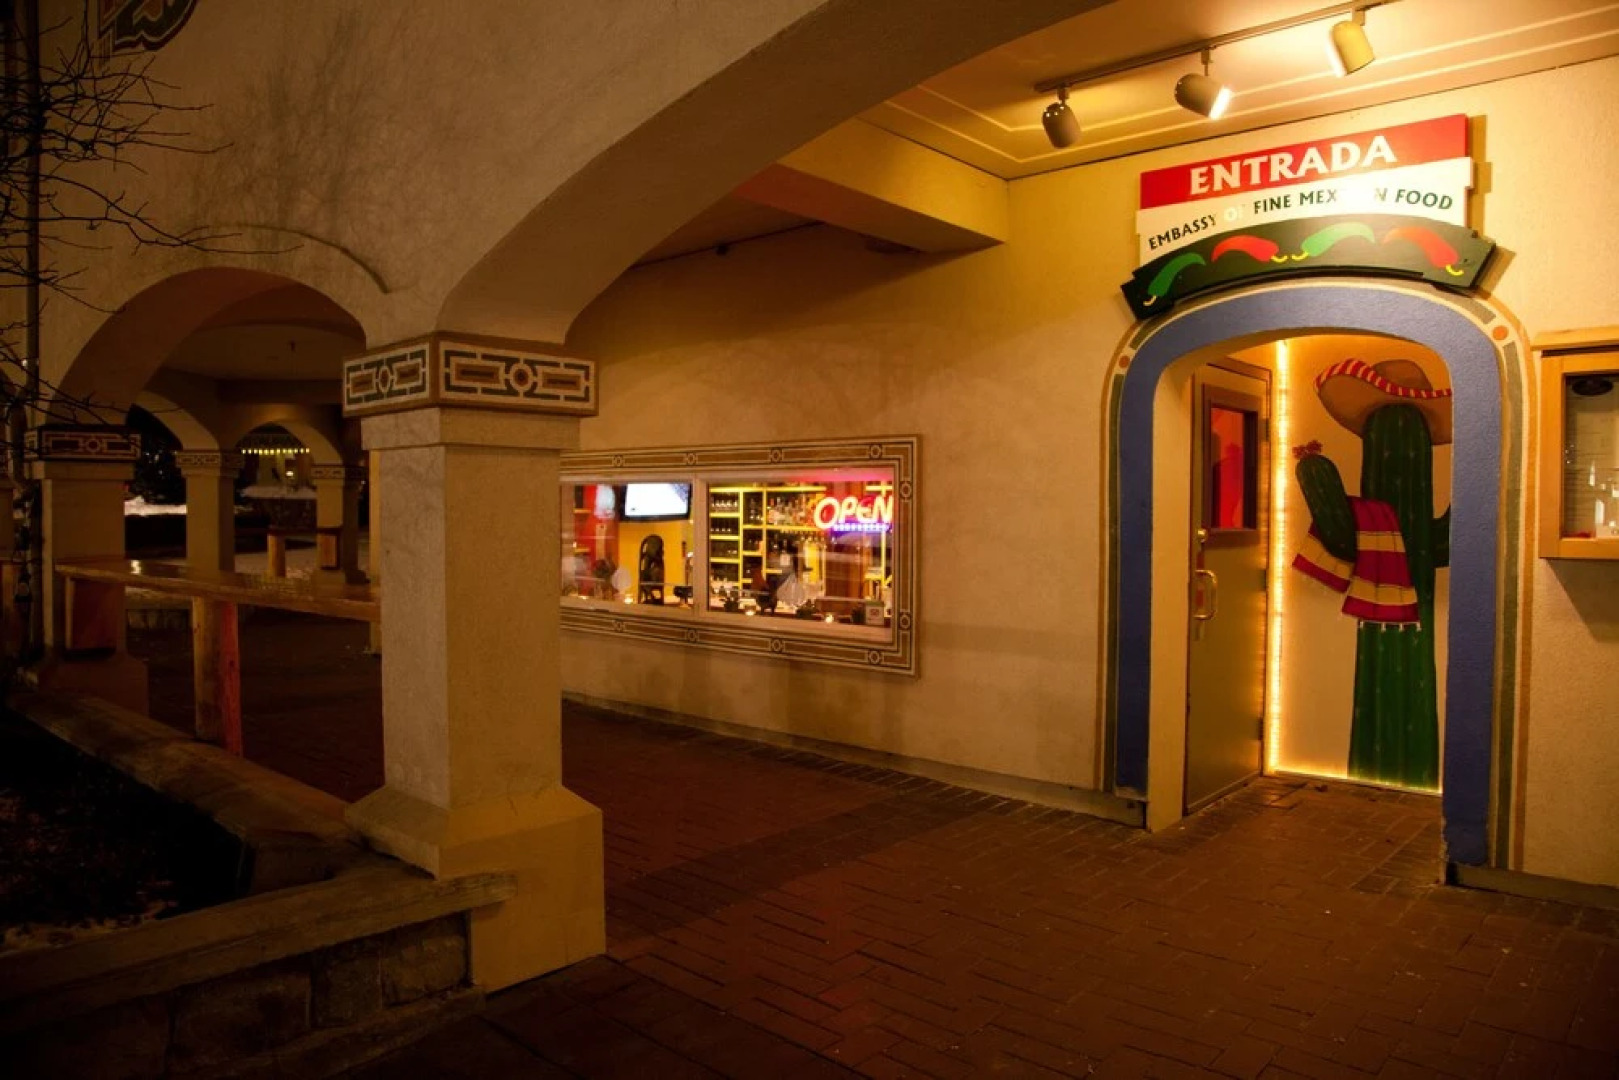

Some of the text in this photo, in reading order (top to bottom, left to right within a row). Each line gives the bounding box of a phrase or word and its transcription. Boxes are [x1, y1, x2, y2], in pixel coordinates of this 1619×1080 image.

[1190, 135, 1397, 195] ENTRADA
[1148, 212, 1218, 250] EMBASSY
[1253, 194, 1292, 214] FINE
[1299, 188, 1388, 206] MEXN
[1394, 188, 1453, 210] FOOD
[815, 496, 893, 529] OPEN
